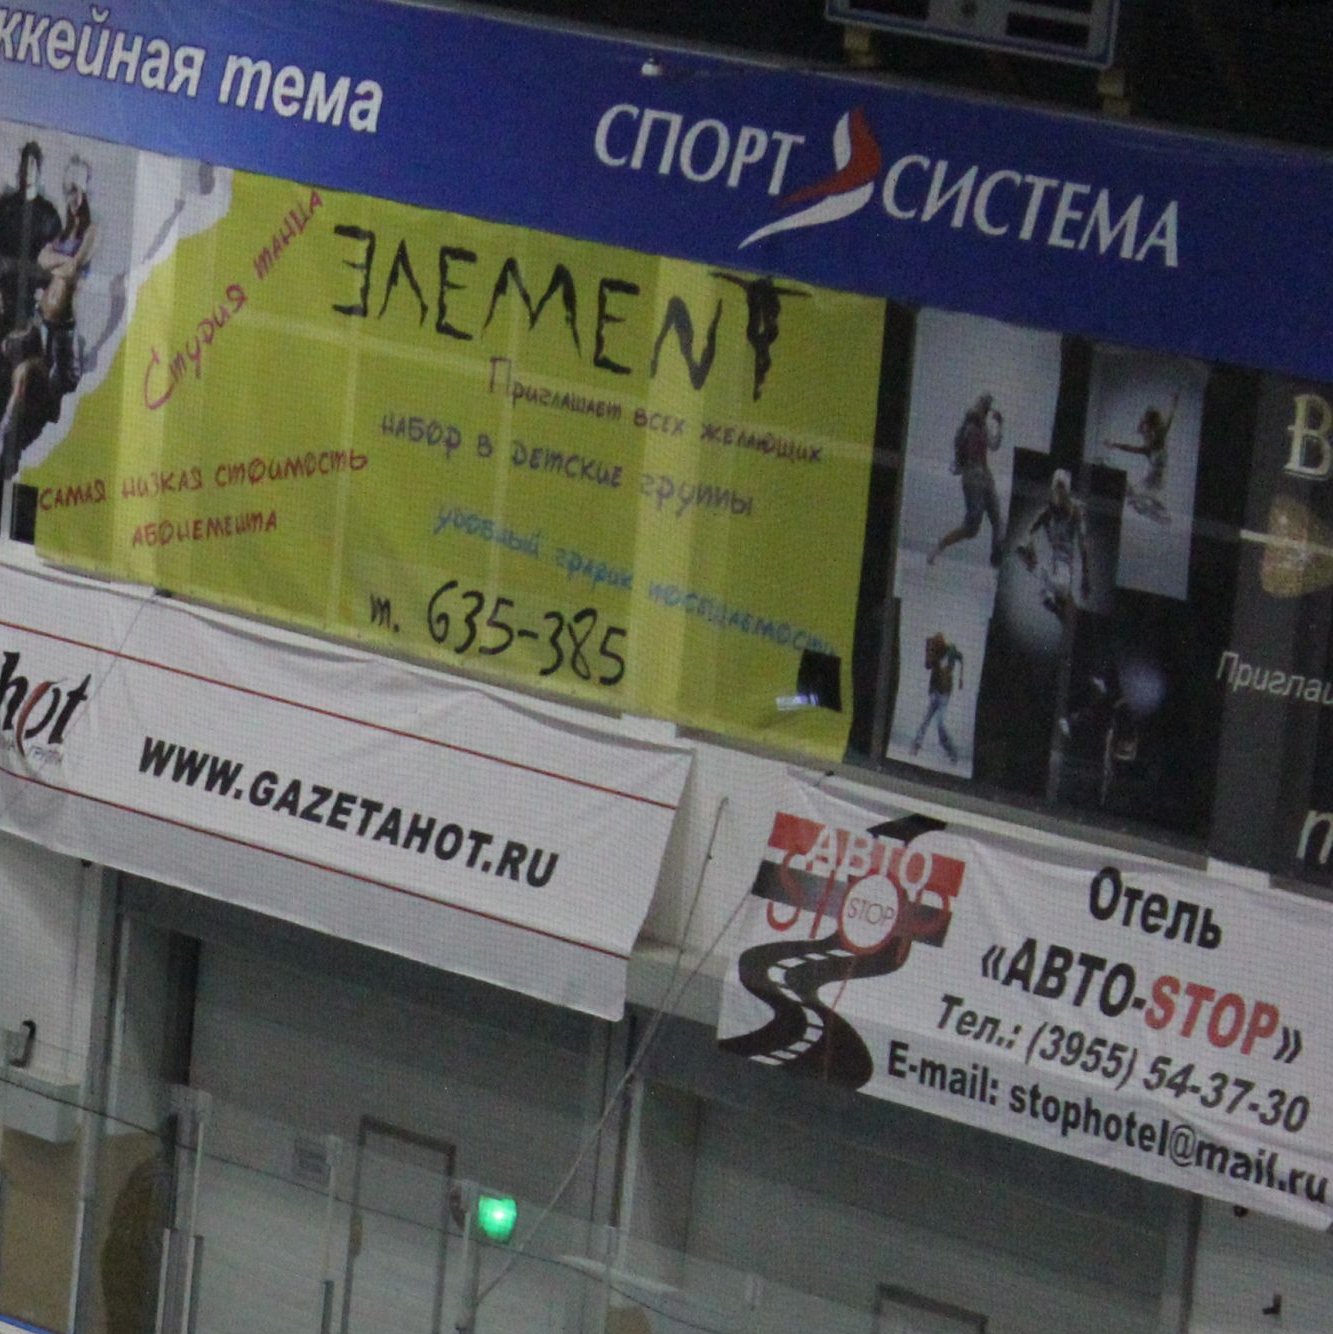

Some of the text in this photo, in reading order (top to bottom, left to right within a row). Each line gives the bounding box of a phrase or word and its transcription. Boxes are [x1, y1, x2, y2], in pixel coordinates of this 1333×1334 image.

[218, 52, 383, 134] тема
[594, 102, 1180, 268] СПОРТ СИСТЕМА
[426, 579, 627, 687] 635-385
[139, 736, 559, 890] WWW.GAZETAHOT.RU
[1088, 865, 1223, 950] Отель
[888, 1039, 1329, 1205] E-mail: stophotel@mail.ru
[934, 994, 1311, 1134] Тел.: (3955) 54-37-30
